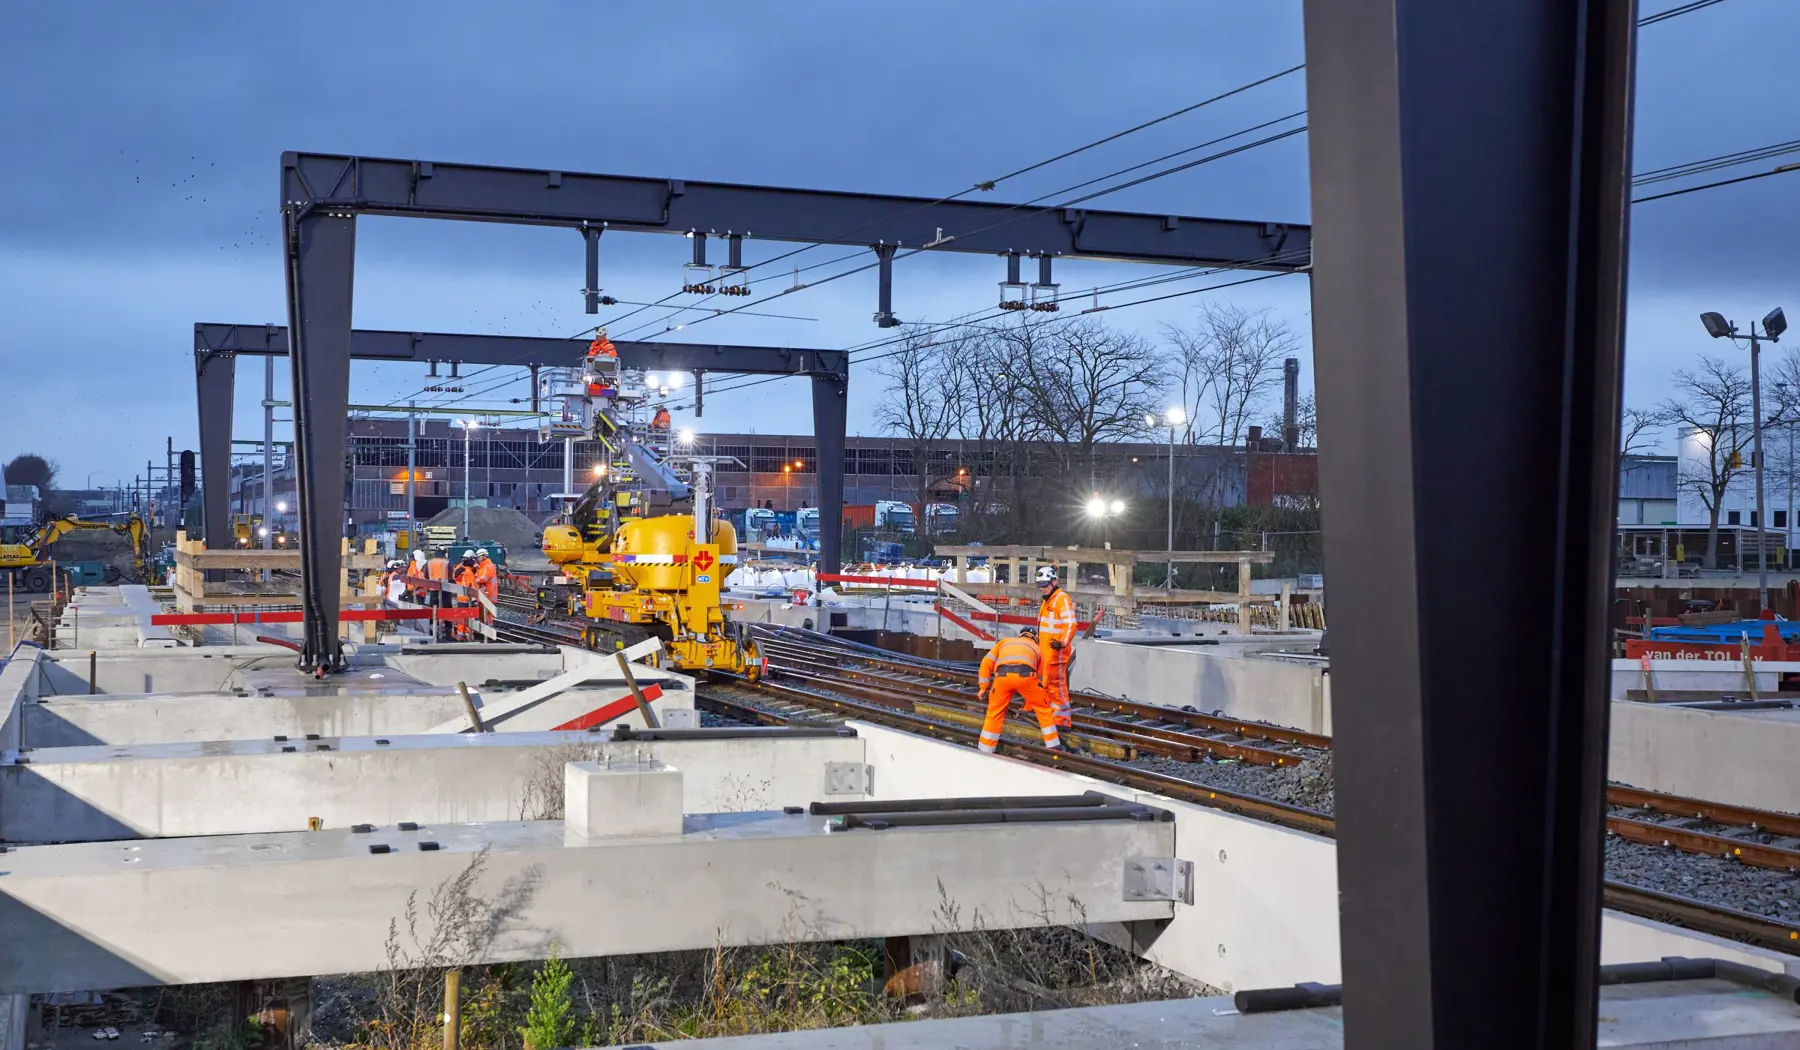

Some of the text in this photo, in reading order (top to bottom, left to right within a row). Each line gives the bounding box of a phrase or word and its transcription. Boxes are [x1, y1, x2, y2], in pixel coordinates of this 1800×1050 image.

[414, 522, 422, 530] 14
[1645, 650, 1671, 660] van
[1676, 649, 1700, 660] der
